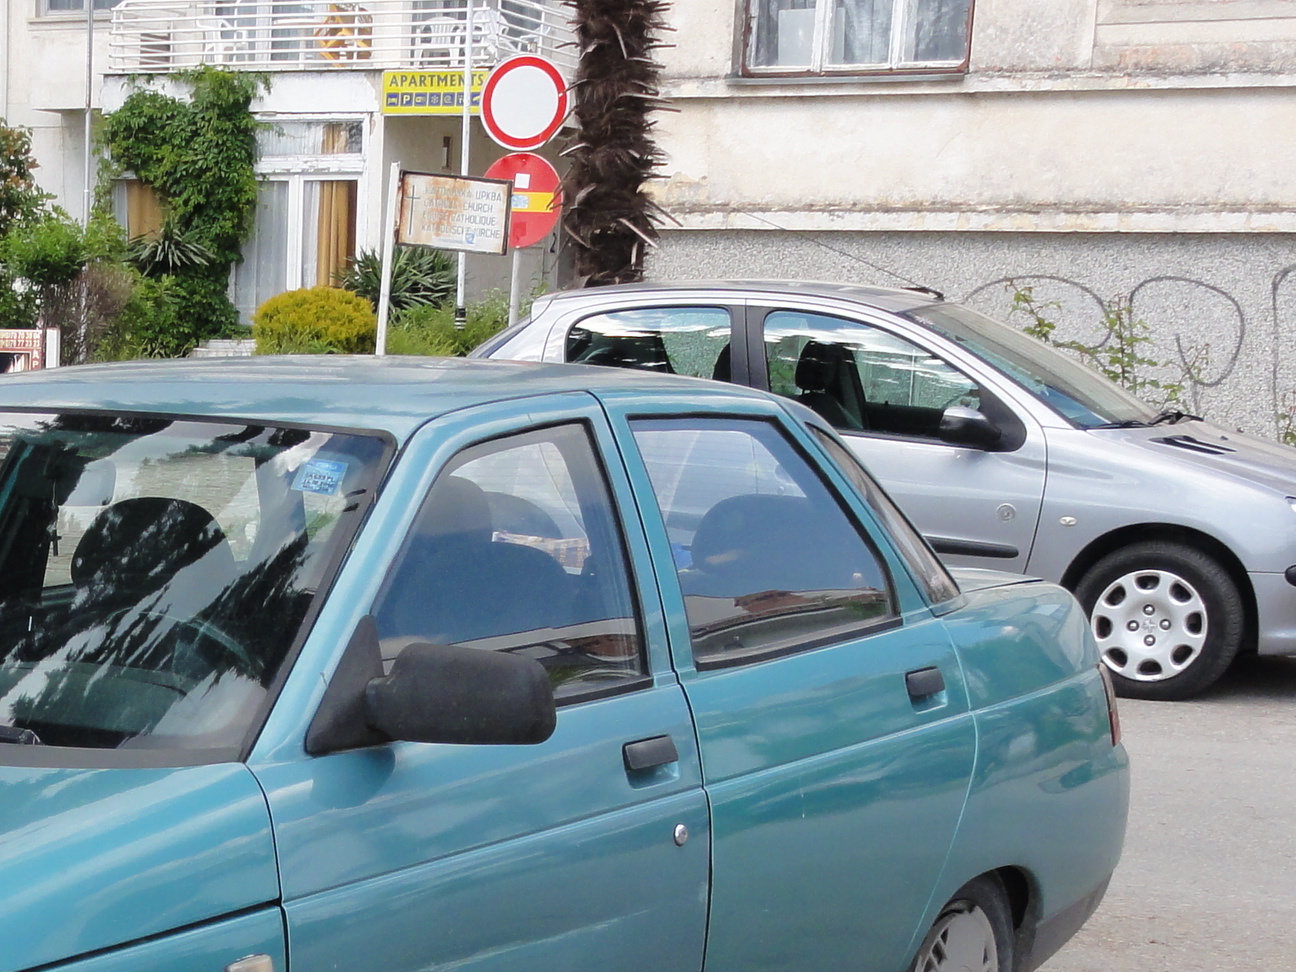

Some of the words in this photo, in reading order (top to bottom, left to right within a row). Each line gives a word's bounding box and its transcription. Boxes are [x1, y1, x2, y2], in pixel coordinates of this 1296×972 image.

[389, 73, 484, 87] APARTMENTS
[463, 202, 493, 213] CHURCH
[450, 213, 496, 226] CATHOLIQUE
